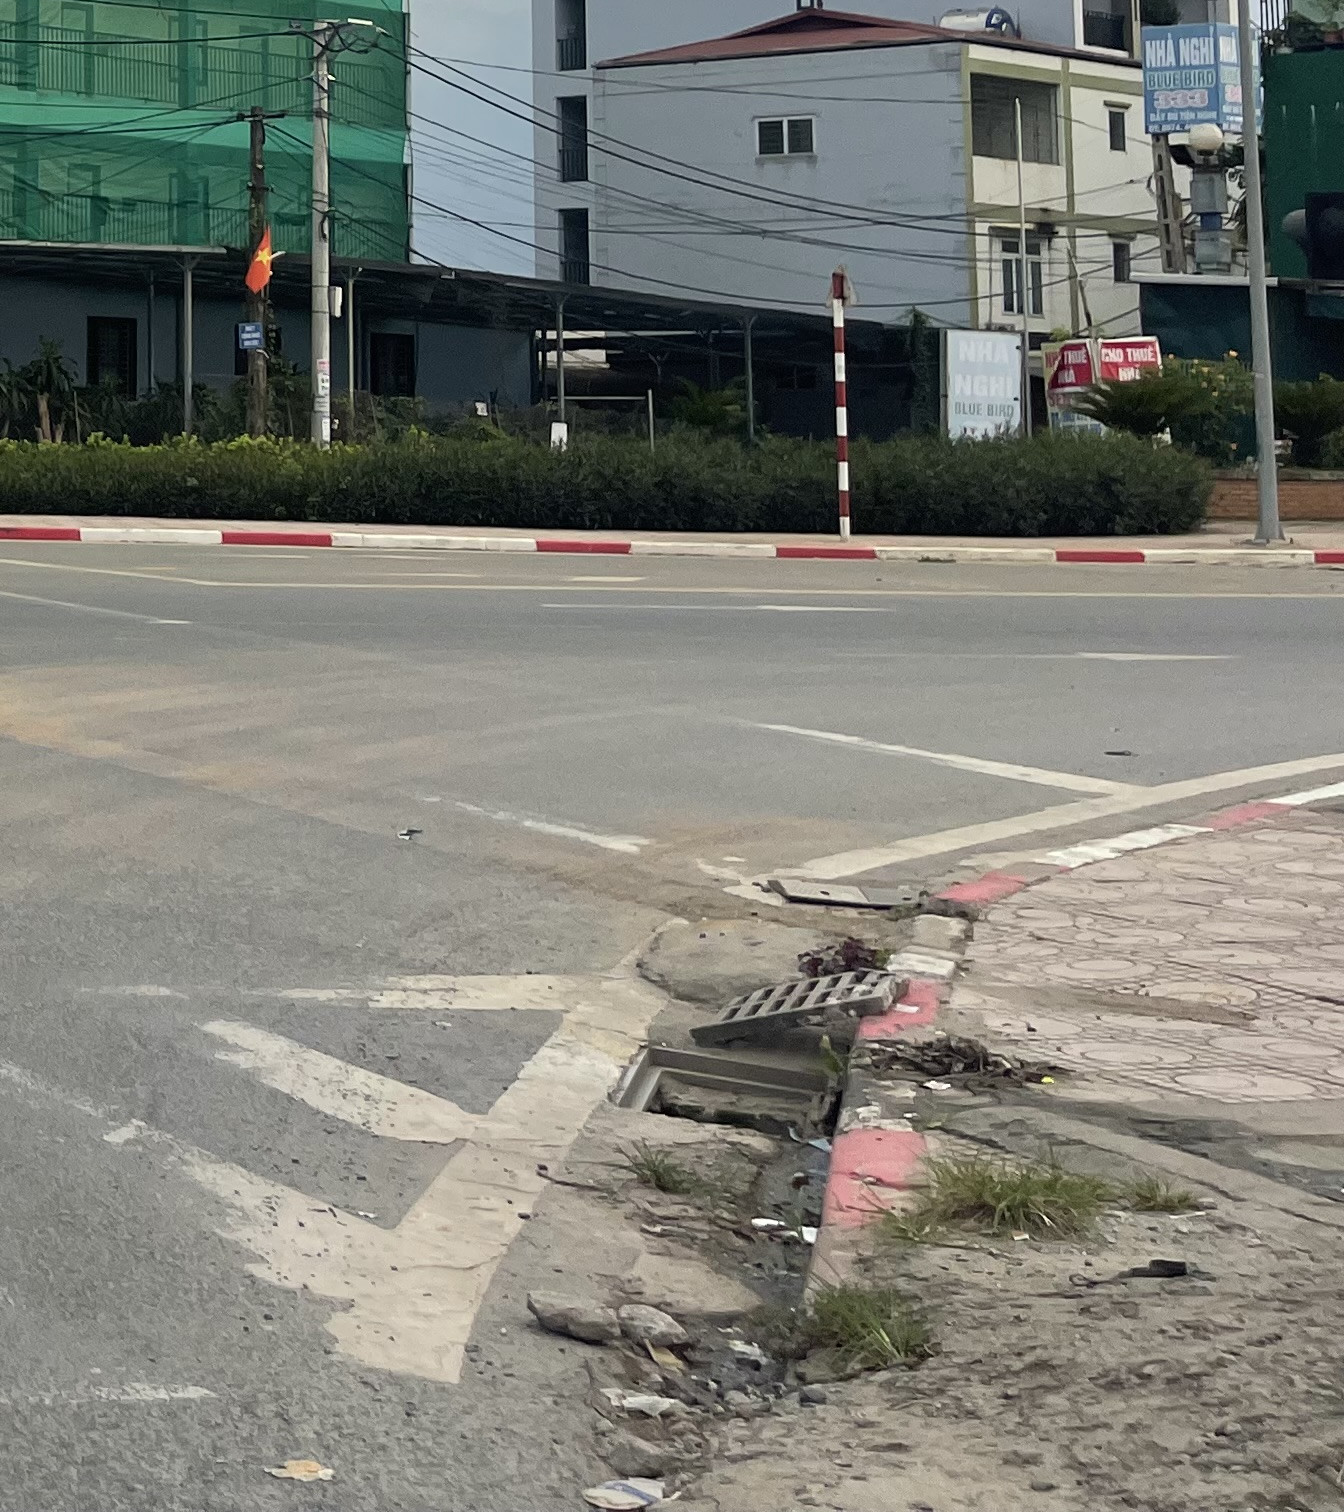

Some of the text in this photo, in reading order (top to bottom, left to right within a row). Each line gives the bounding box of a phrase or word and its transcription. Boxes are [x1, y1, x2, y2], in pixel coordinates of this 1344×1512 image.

[1145, 26, 1214, 68] NHÀ NGHỈ
[1147, 70, 1216, 89] BLUE BIRD
[1153, 89, 1208, 108] 333
[1101, 345, 1156, 363] CHO THUÊ
[955, 402, 1015, 417] BLUE BIRD
